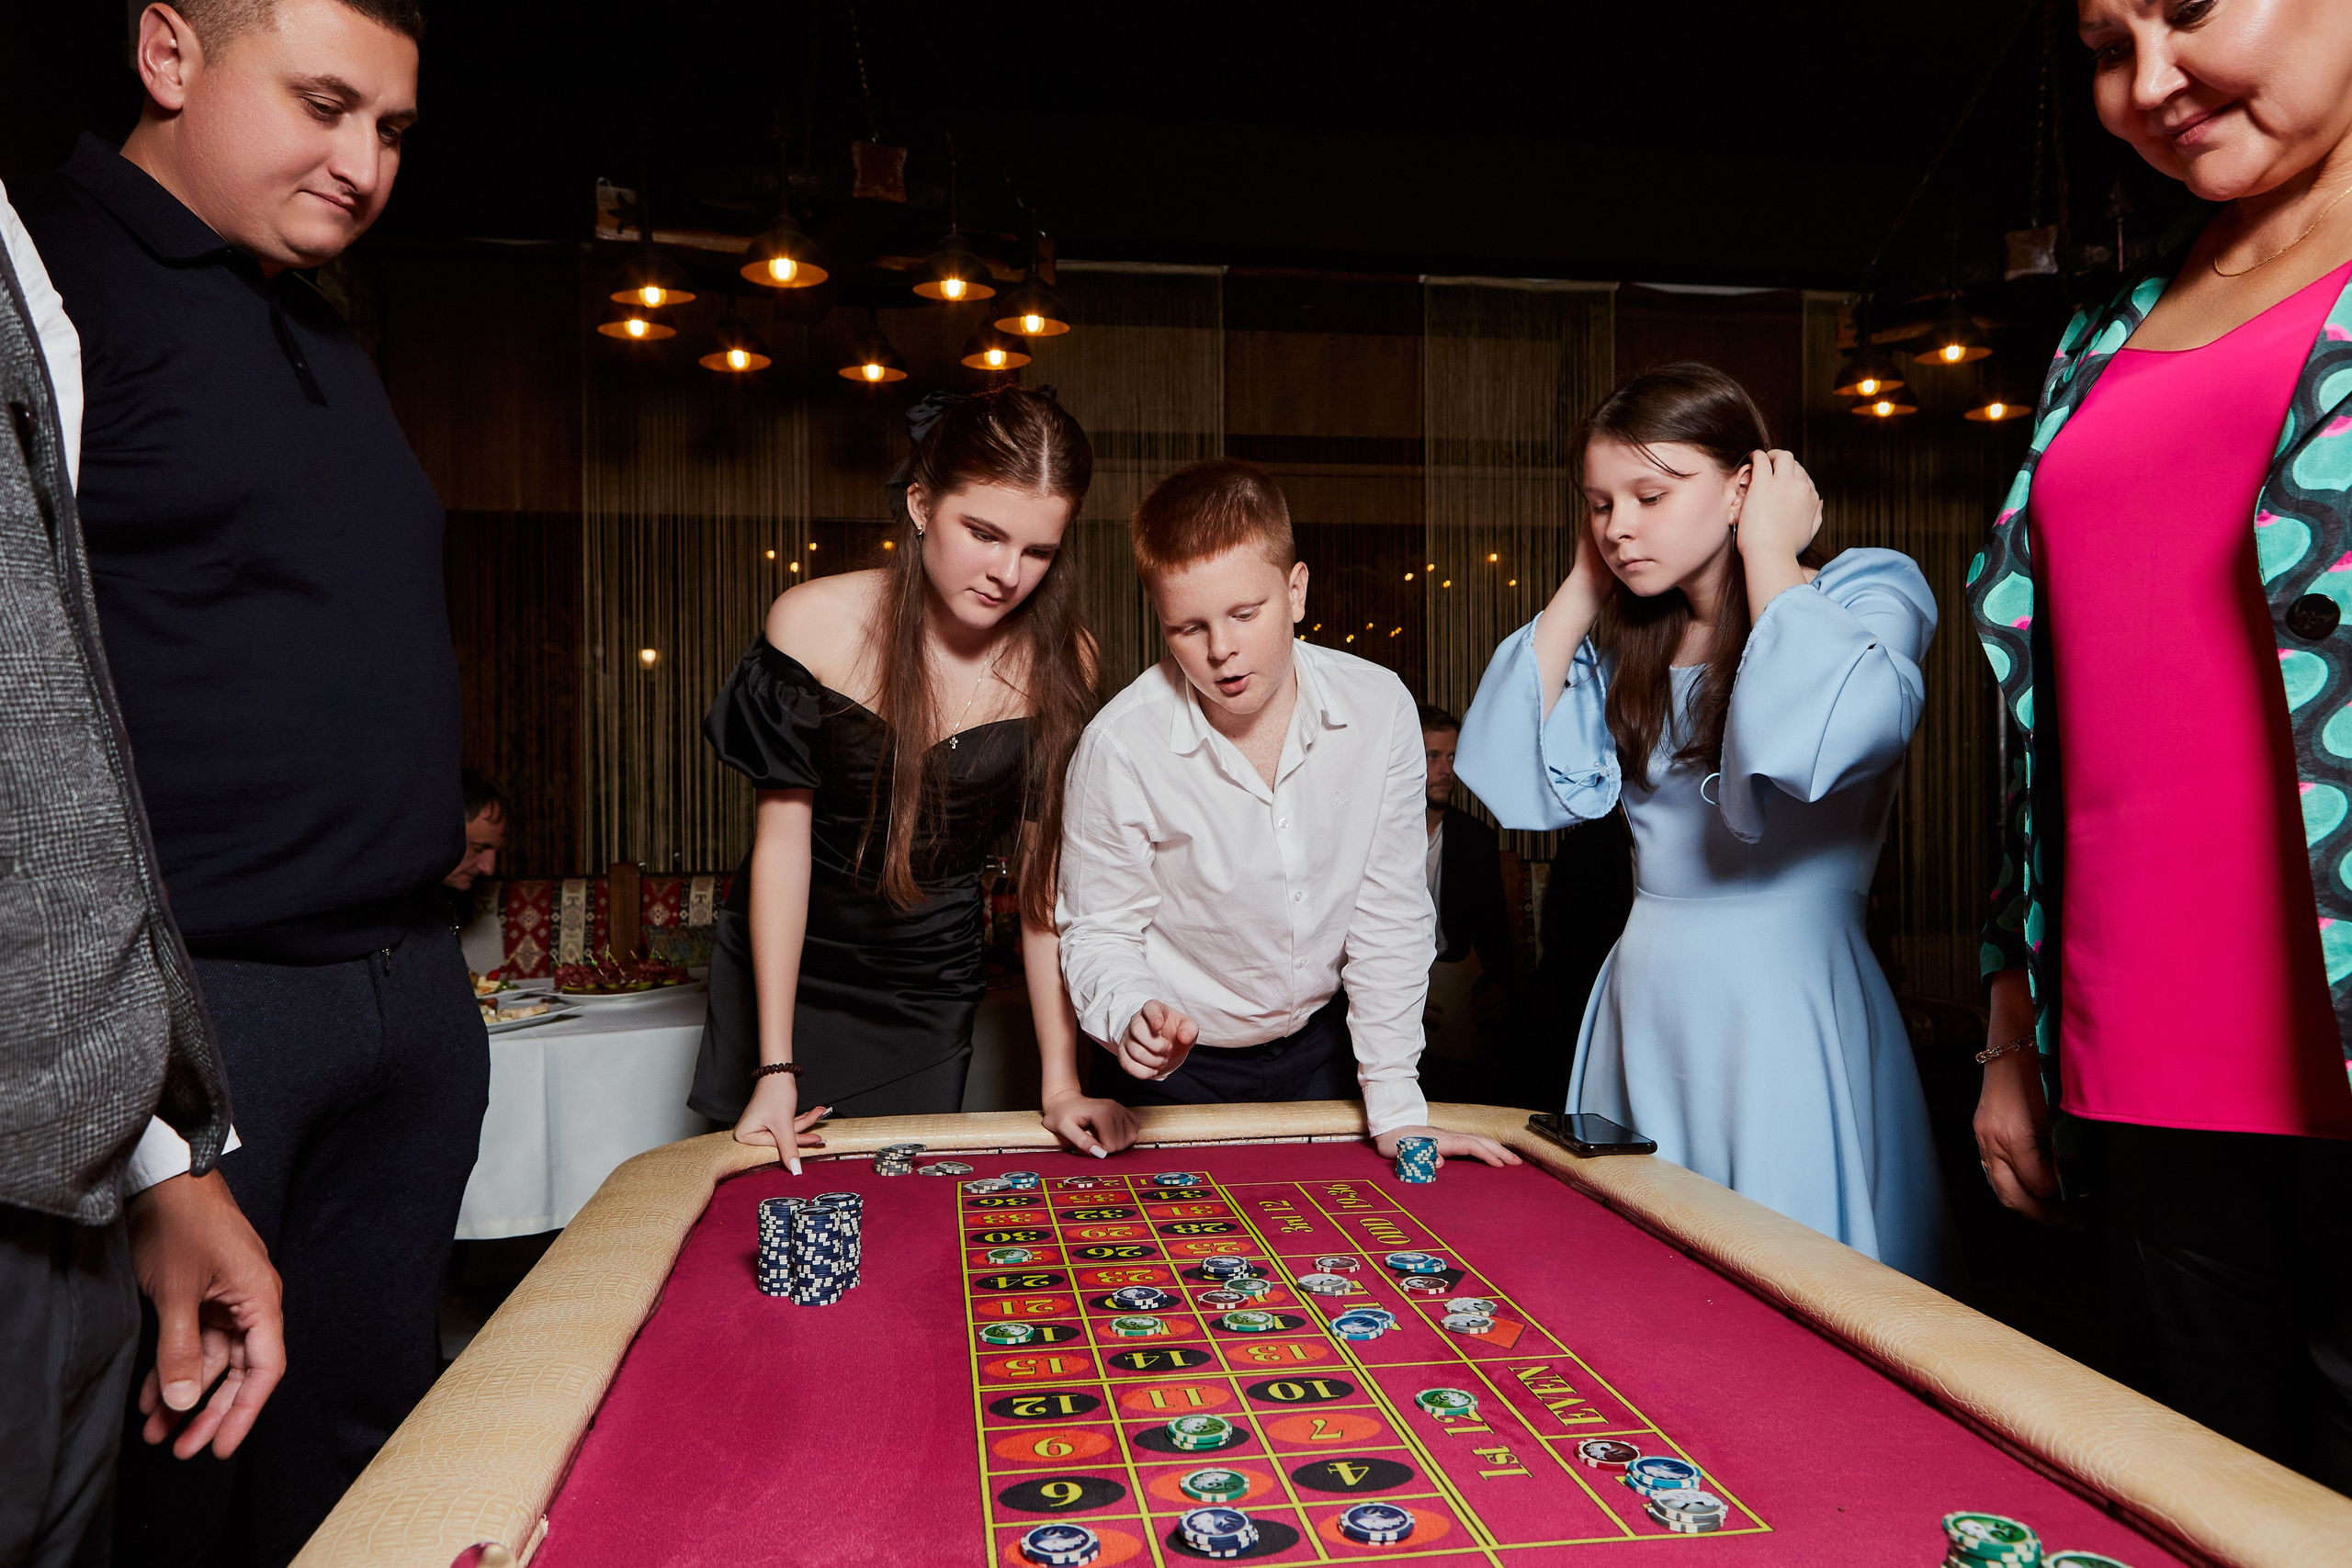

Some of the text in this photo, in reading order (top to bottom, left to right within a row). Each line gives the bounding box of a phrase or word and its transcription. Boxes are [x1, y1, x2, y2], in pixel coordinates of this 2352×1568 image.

[979, 1197, 1028, 1206] 36
[1069, 1193, 1115, 1203] 35
[1154, 1190, 1203, 1200] 34
[1321, 1184, 1374, 1209] 19-36
[1074, 1209, 1123, 1220] 32
[1170, 1205, 1215, 1216] 31
[1259, 1200, 1314, 1233] 3rd 12
[982, 1213, 1032, 1224] 33
[1080, 1226, 1133, 1238] 29
[1172, 1222, 1227, 1234] 28
[1359, 1218, 1411, 1245] ODD
[984, 1231, 1036, 1243] 30
[1086, 1246, 1143, 1258] 26
[1186, 1241, 1241, 1255] 25
[991, 1274, 1050, 1289] 24
[1097, 1269, 1154, 1283] 23
[995, 1299, 1055, 1315] 21
[1125, 1349, 1193, 1369] 14
[1247, 1343, 1314, 1363] 13
[1005, 1356, 1068, 1377] 15
[1267, 1379, 1341, 1401] 10
[1507, 1365, 1610, 1427] EVEN
[1012, 1393, 1080, 1417] 12
[1147, 1386, 1210, 1410] 11
[1195, 1422, 1224, 1433] 25
[1310, 1418, 1342, 1440] 7
[1034, 1435, 1074, 1458] 9
[1471, 1445, 1533, 1481] 1st
[1327, 1461, 1370, 1485] 4
[1040, 1481, 1083, 1507] 6
[1207, 1482, 1238, 1491] 25
[1363, 1506, 1394, 1519] 50
[1217, 1516, 1243, 1531] 50
